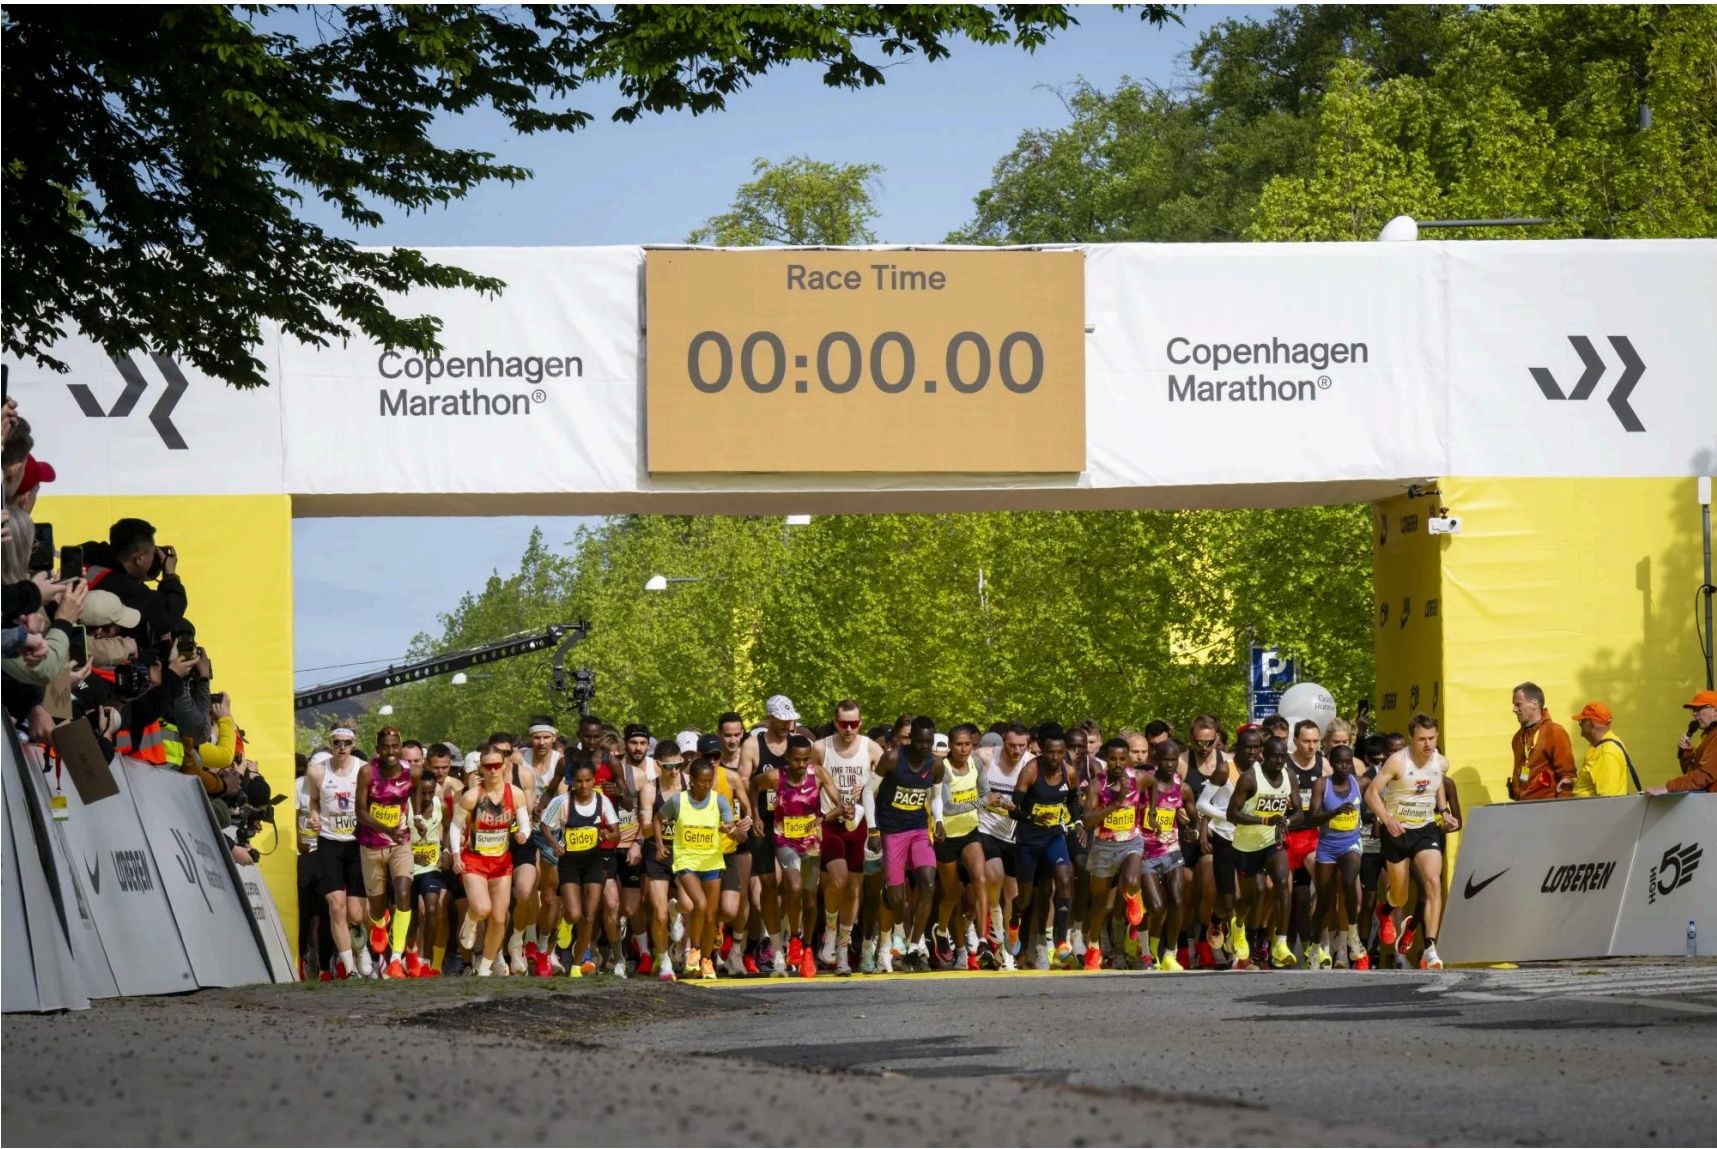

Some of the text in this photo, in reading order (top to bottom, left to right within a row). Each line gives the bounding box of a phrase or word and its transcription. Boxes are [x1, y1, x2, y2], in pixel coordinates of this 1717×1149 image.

[787, 264, 947, 290] Race Time
[687, 330, 1044, 394] 00:00.00
[1166, 336, 1369, 371] Copenhagen
[378, 350, 583, 384] Copenhagen
[1167, 374, 1332, 402] Marathon®
[379, 388, 547, 416] Marathon®
[1262, 652, 1287, 688] P
[839, 775, 857, 787] CLUB
[845, 766, 863, 777] TRACK
[894, 791, 925, 805] PACE
[1257, 798, 1287, 811] PACE
[372, 807, 399, 823] Tesfaye
[1107, 814, 1134, 825] Bantie
[1399, 807, 1427, 817] Johnsen
[569, 832, 594, 845] Gidey
[684, 831, 713, 843] Getnet
[1541, 861, 1617, 893] LØBEREN
[1648, 866, 1657, 905] HIGH
